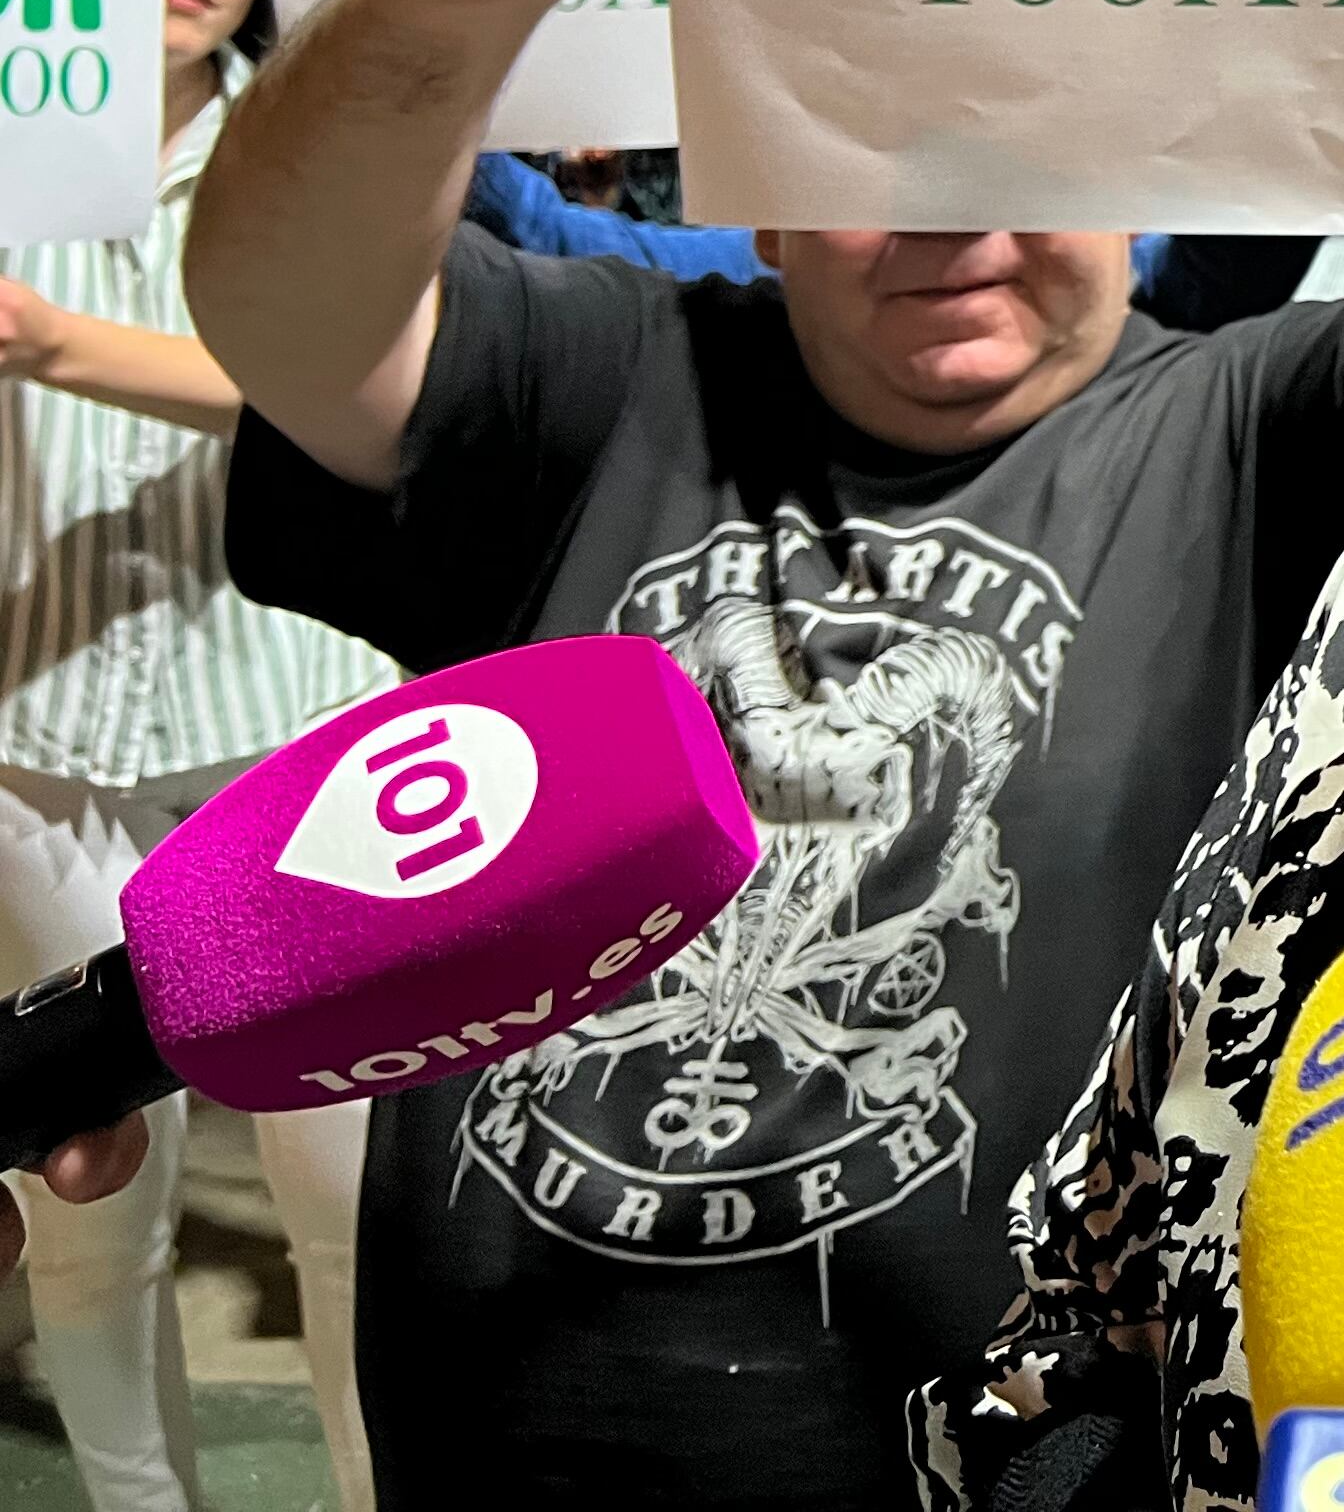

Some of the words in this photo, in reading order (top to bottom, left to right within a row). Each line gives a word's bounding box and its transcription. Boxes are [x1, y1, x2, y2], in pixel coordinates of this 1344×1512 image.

[366, 717, 485, 882] 101
[299, 900, 684, 1093] 101tv.es
[475, 1098, 942, 1245] MURDER
